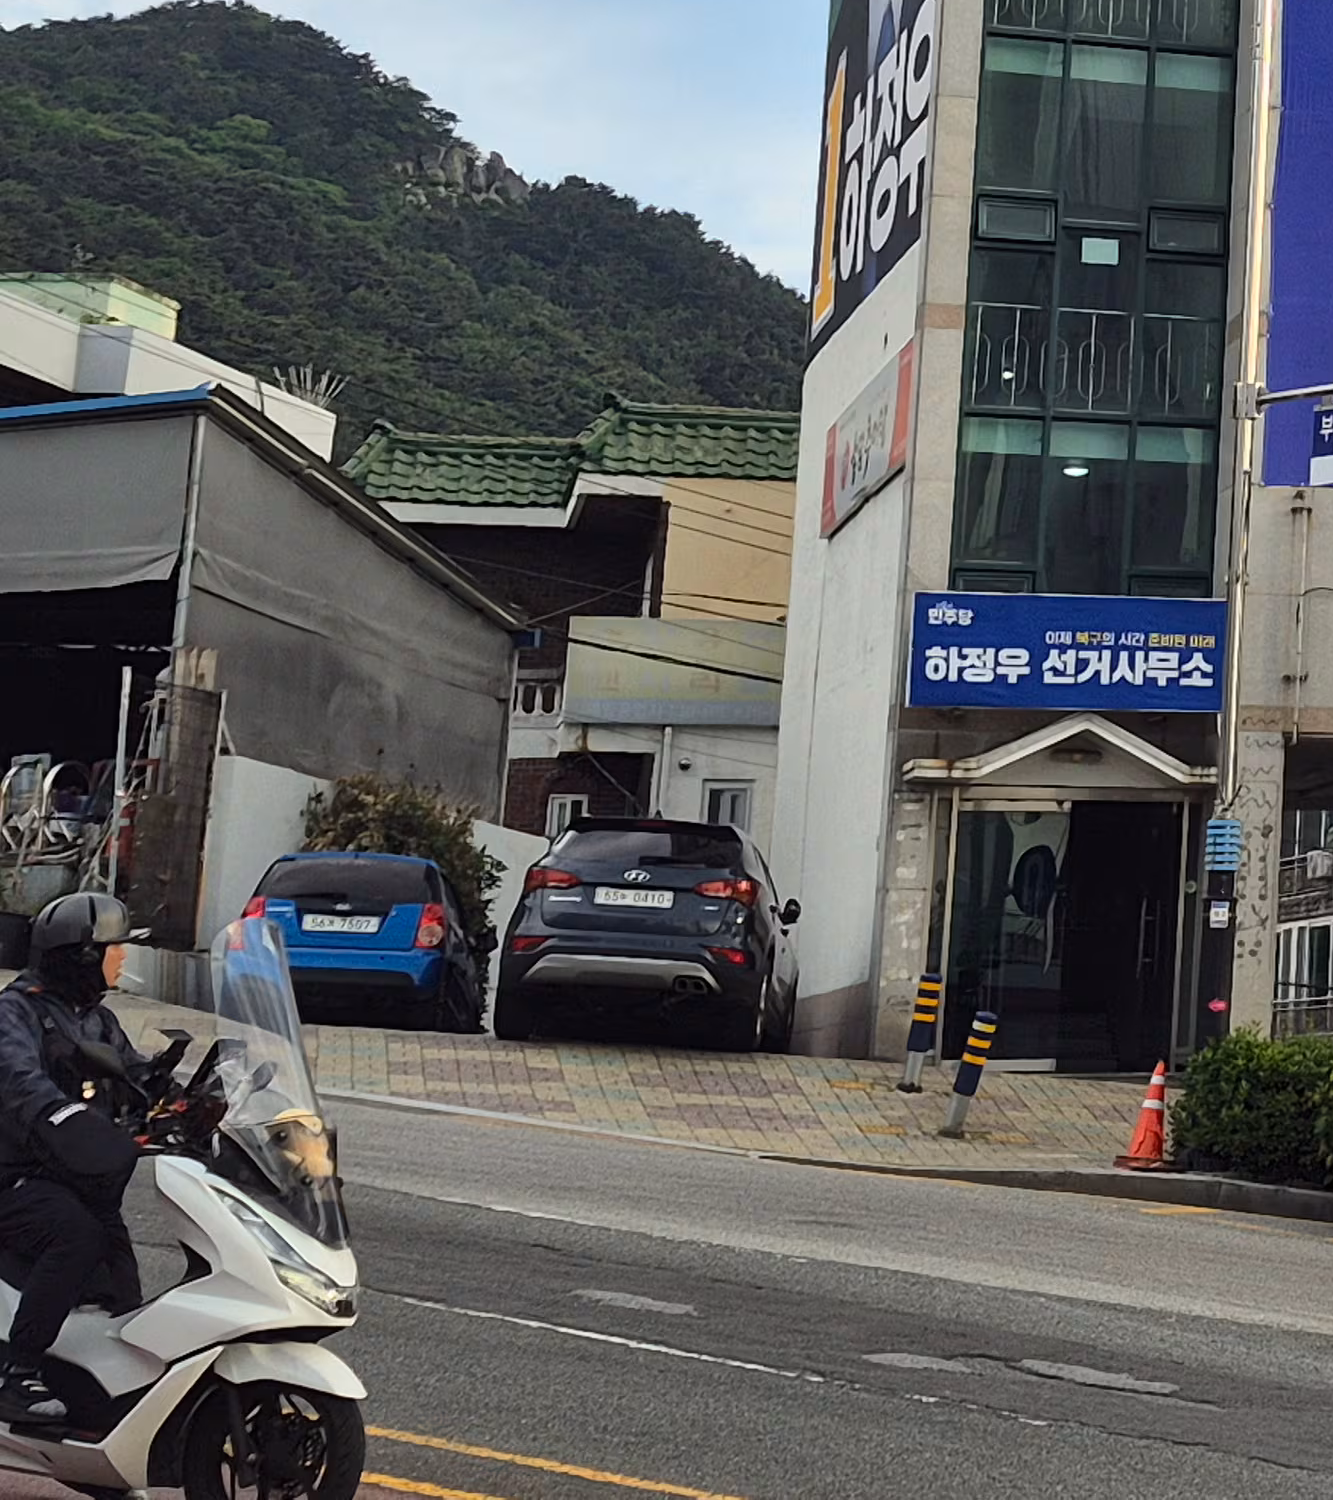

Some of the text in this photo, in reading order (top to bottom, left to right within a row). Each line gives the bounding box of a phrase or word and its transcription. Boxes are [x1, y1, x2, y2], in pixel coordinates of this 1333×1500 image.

[813, 48, 847, 340] 1
[928, 607, 974, 626] 민주당
[1045, 630, 1073, 645] 이제
[1076, 630, 1115, 646] 북구의
[1118, 631, 1145, 647] 시간
[1189, 634, 1216, 649] 미래
[925, 646, 1215, 687] 하정우 선거사무소
[632, 893, 665, 905] 0410
